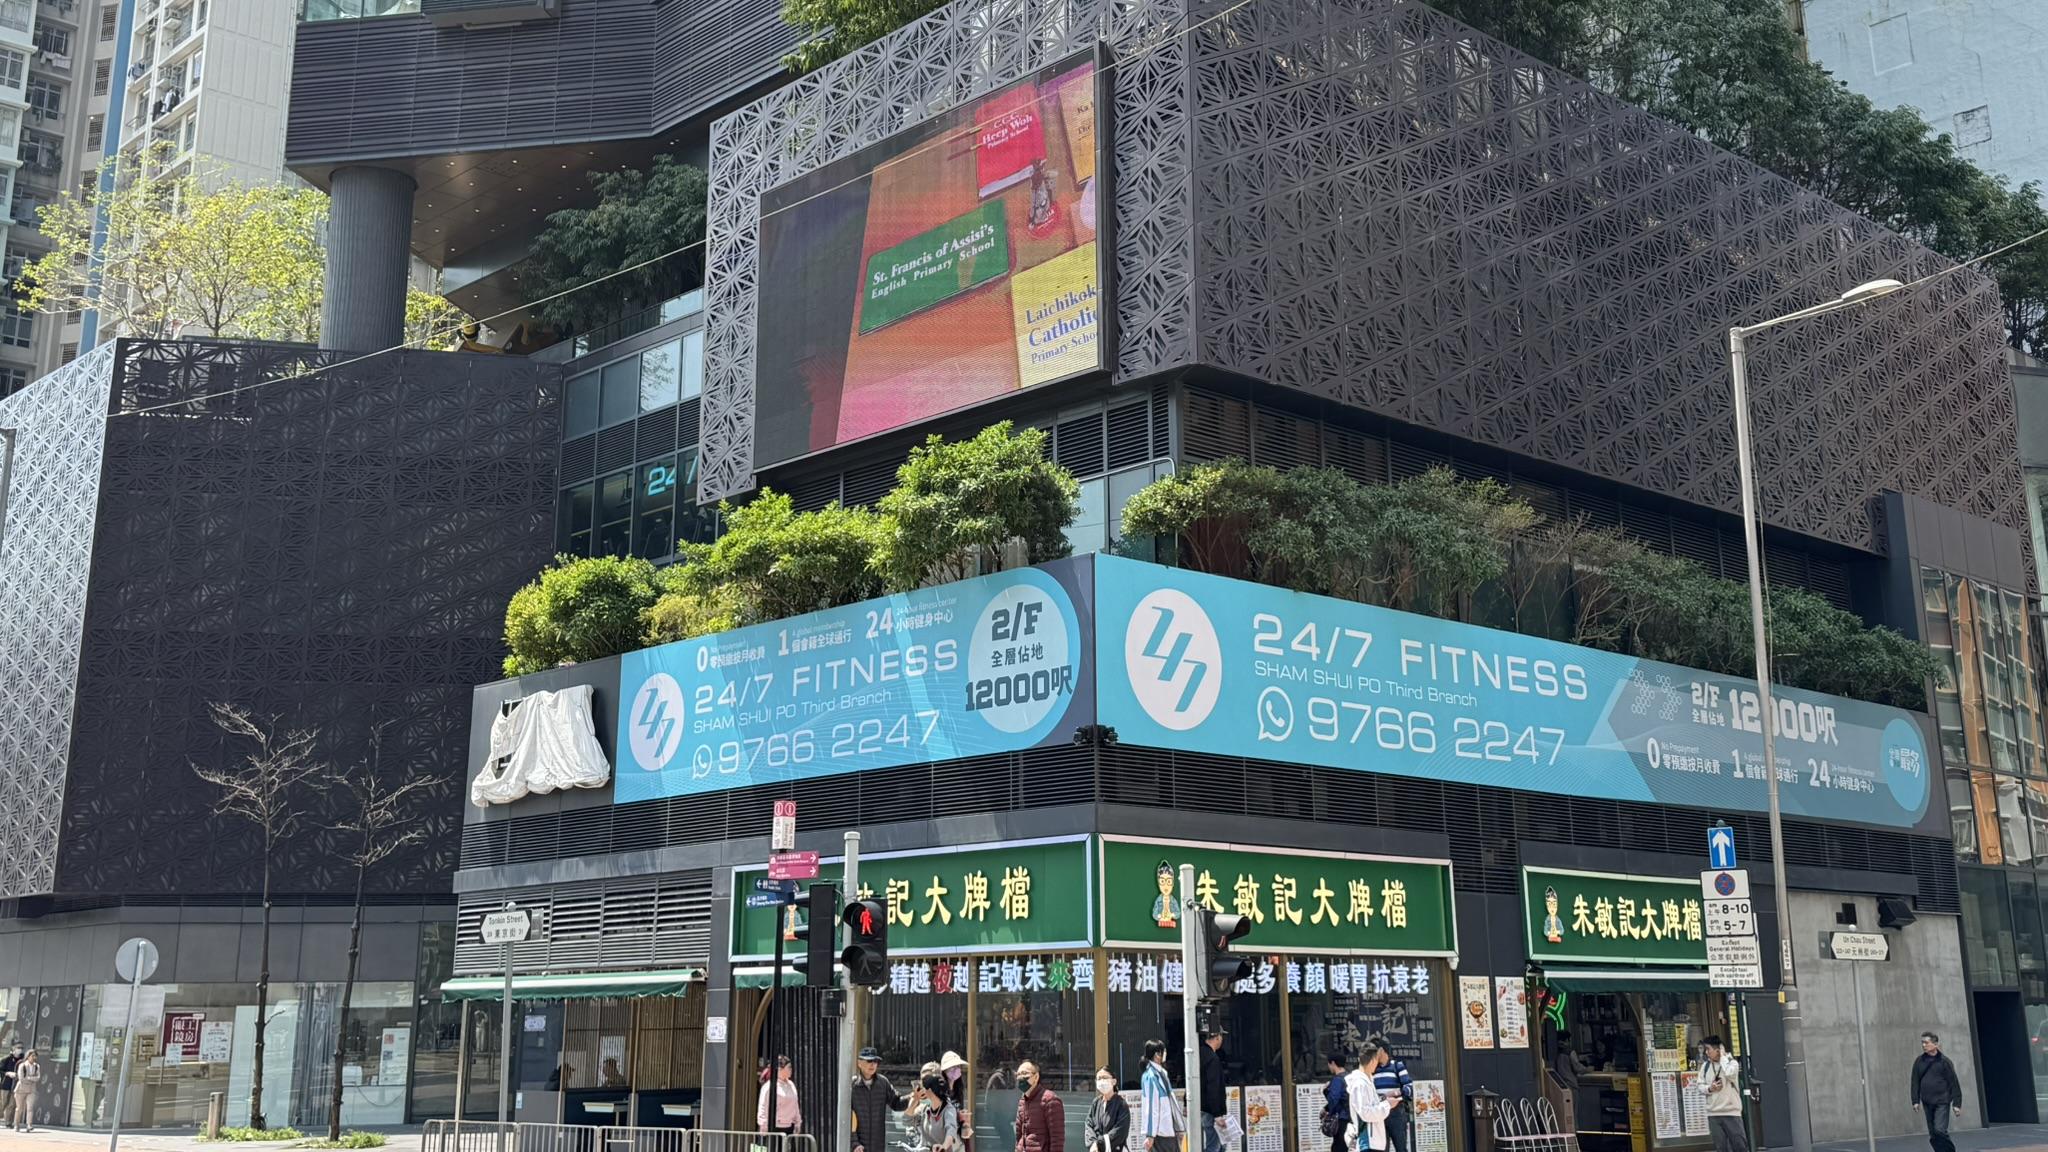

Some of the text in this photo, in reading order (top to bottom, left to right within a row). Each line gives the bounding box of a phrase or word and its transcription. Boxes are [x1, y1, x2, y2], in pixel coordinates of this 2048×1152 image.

[982, 127, 1008, 144] Heep
[871, 237, 994, 299] English Primary School
[873, 224, 994, 285] St. Francis of Assisi's
[1026, 284, 1096, 324] Laichikok
[1032, 344, 1067, 364] Primary
[866, 607, 894, 639] 24
[896, 609, 953, 633] 小時健身中心
[992, 601, 1043, 641] 2/F
[778, 629, 789, 656] 1
[991, 642, 1043, 668] 全層佔地
[1253, 613, 1588, 700] 24/7 FITNESS
[697, 646, 708, 672] 0
[694, 638, 958, 715] 24/7 FITNESS
[966, 665, 1073, 712] 12000呎
[1255, 660, 1477, 707] SHAM SHUI PO Third Branch
[694, 688, 892, 734] SHAM SHUI PO Third Branch
[1691, 681, 1720, 709] 2/F
[1307, 696, 1565, 766] 9766 2247
[1691, 708, 1726, 727] 全層佔地
[719, 709, 940, 775] 9766 2247
[1647, 737, 1660, 769] 0
[1731, 749, 1744, 778] 1
[1807, 758, 1831, 788] 24
[1195, 869, 1408, 929] 朱敏記大牌檔
[1722, 903, 1749, 915] 8-10
[1572, 893, 1702, 942] 朱敏記大牌檔
[1723, 920, 1747, 931] 5-7
